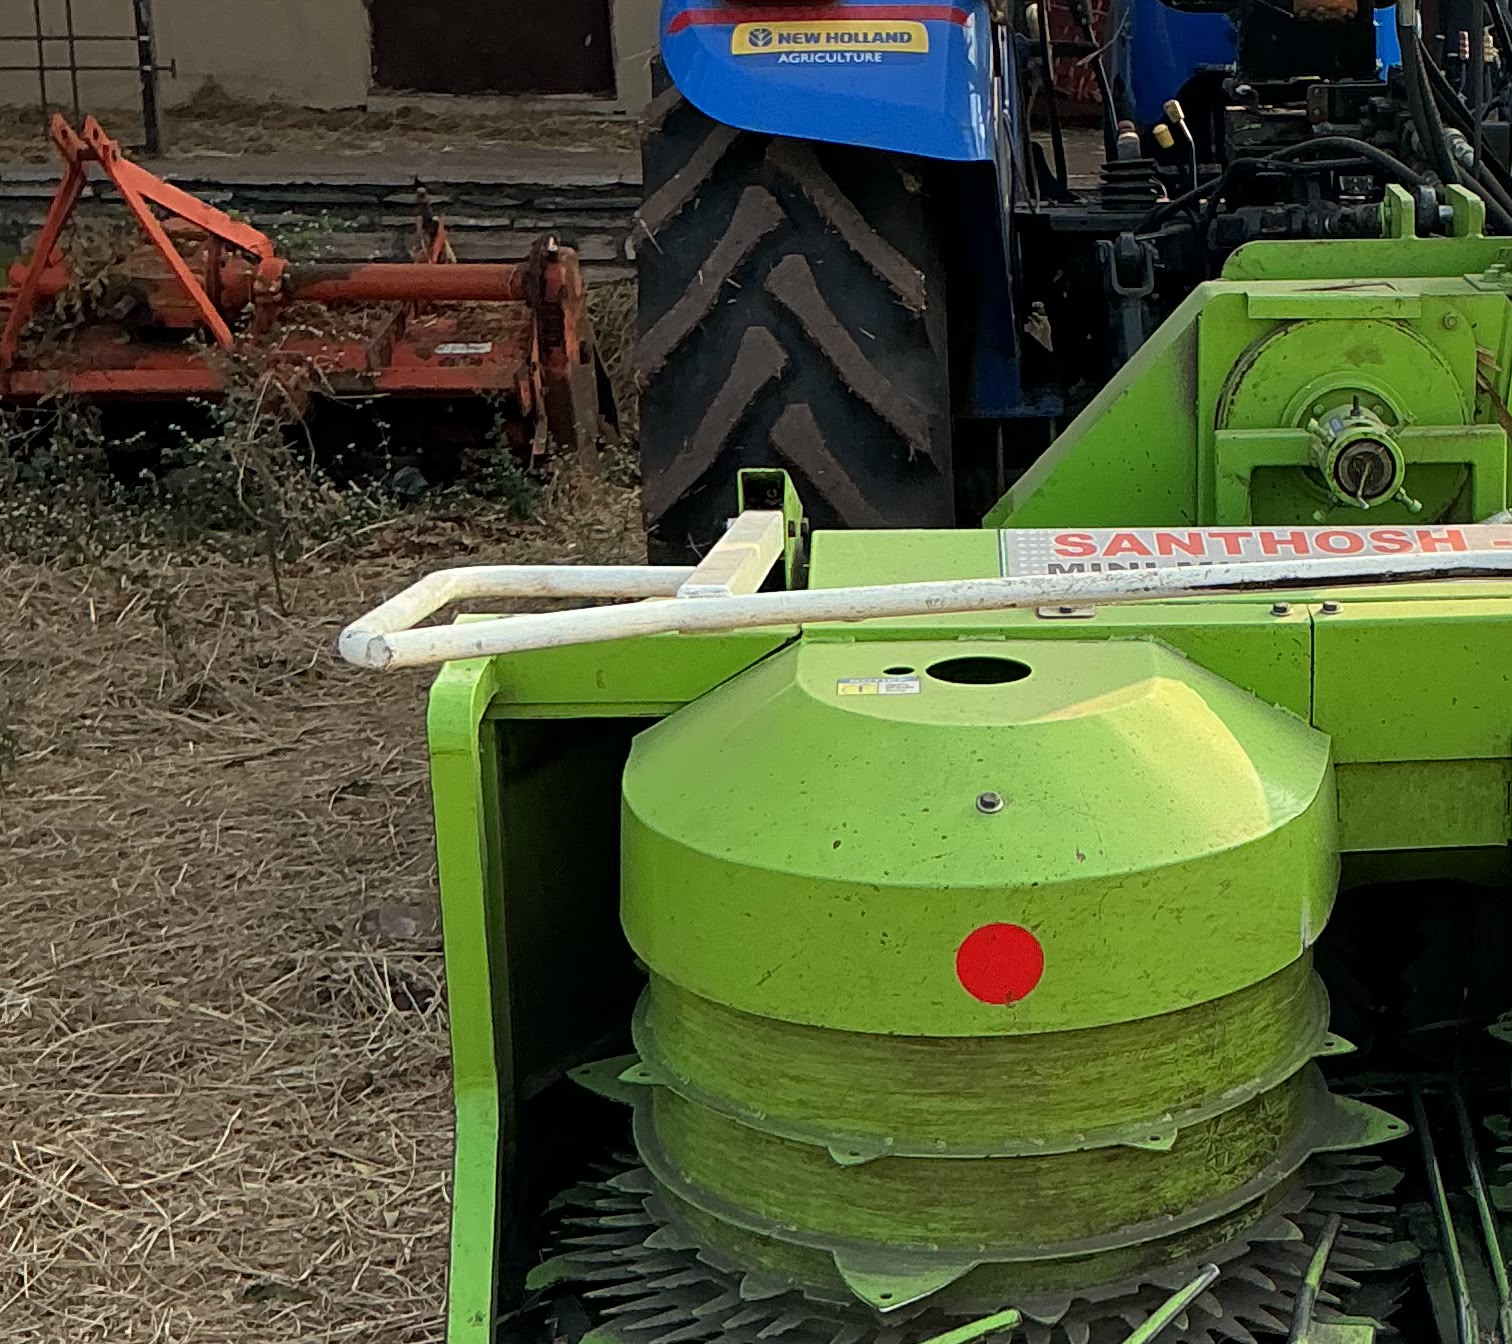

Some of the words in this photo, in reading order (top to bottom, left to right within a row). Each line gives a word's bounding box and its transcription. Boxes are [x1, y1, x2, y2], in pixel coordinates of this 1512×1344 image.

[778, 32, 821, 44] NEW
[825, 31, 913, 44] HOLLAND
[777, 52, 883, 64] AGRICULTURE
[1053, 529, 1468, 557] SANTHOSH
